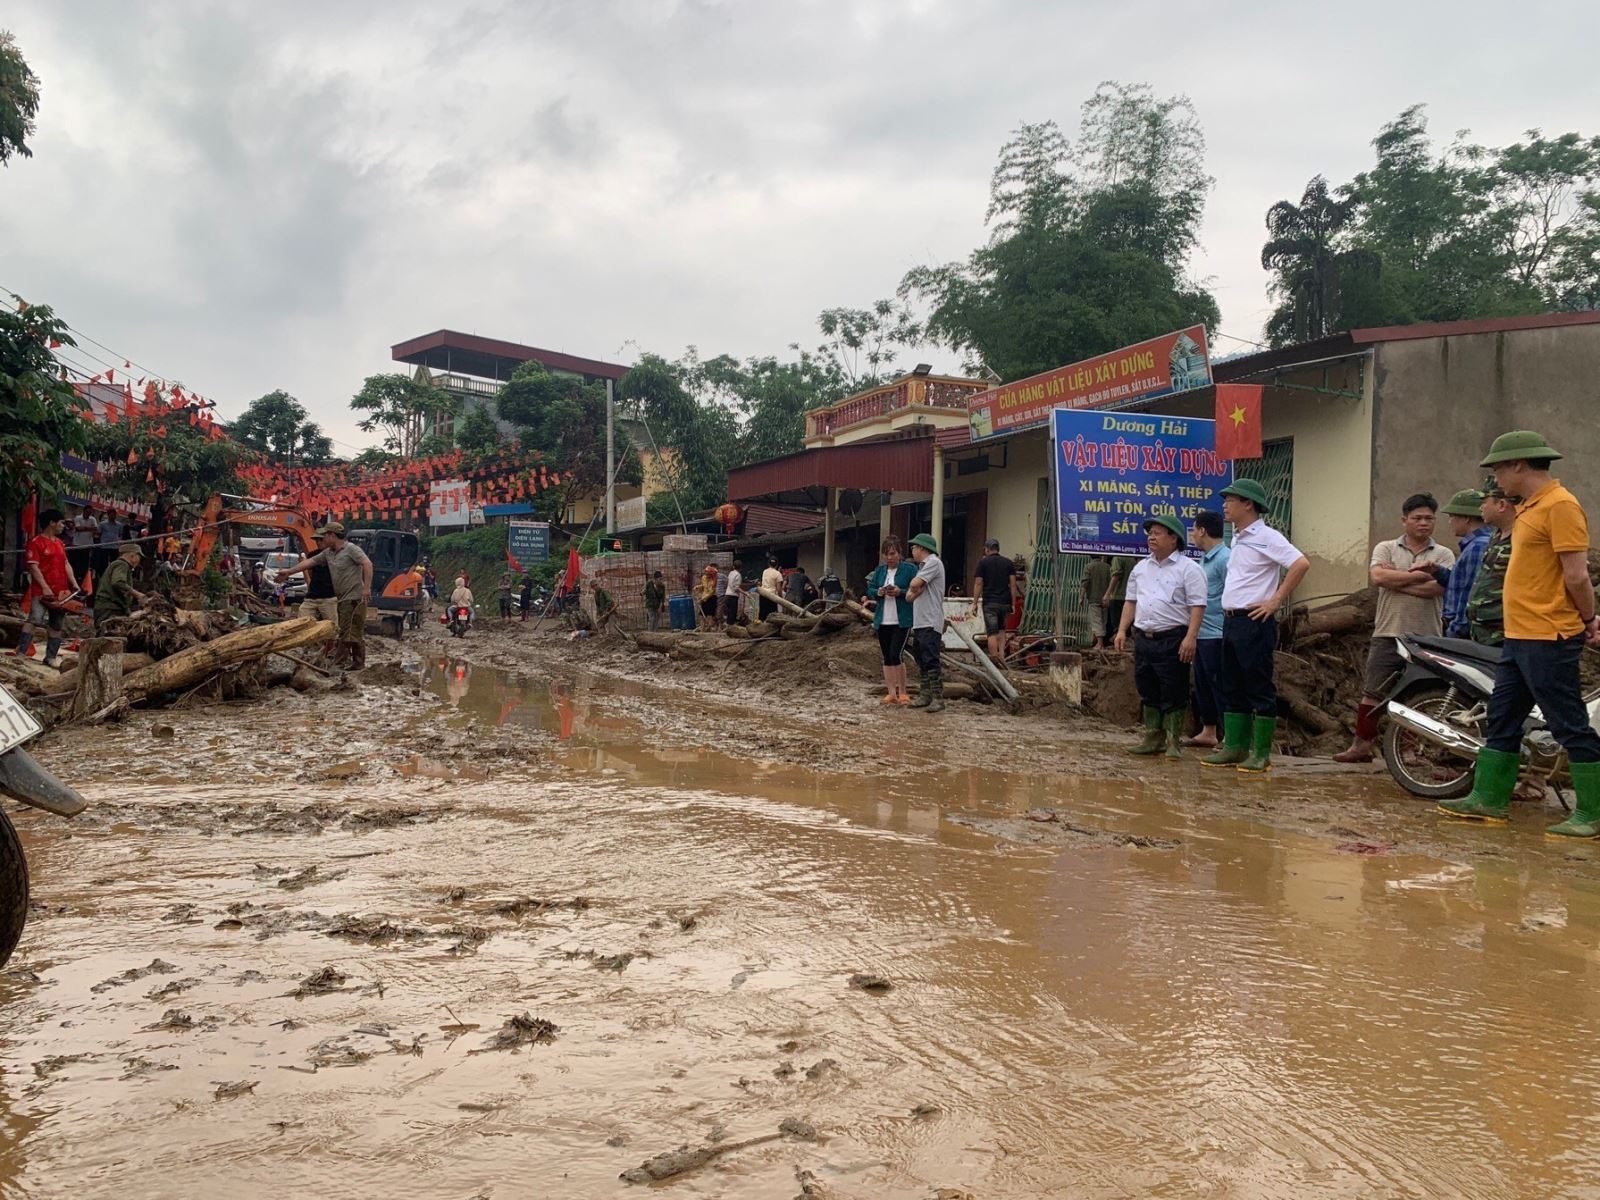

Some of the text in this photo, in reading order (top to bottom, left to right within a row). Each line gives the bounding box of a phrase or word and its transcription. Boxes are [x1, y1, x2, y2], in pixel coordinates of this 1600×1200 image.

[1000, 351, 1155, 410] CỬA HÀNG VẬT LIỆU XÂY DỰNG
[1102, 416, 1188, 436] Dương Hải
[1061, 433, 1098, 473] VẬT
[1100, 436, 1139, 475] LIỆU
[1142, 439, 1177, 473] XÂY
[1079, 479, 1213, 500] XI MĂNG, SẮT, THÉP
[1084, 498, 1111, 513] MÁI
[1114, 499, 1147, 517] TÔN,
[1151, 499, 1177, 517] CỬA
[1112, 518, 1139, 535] SẮT
